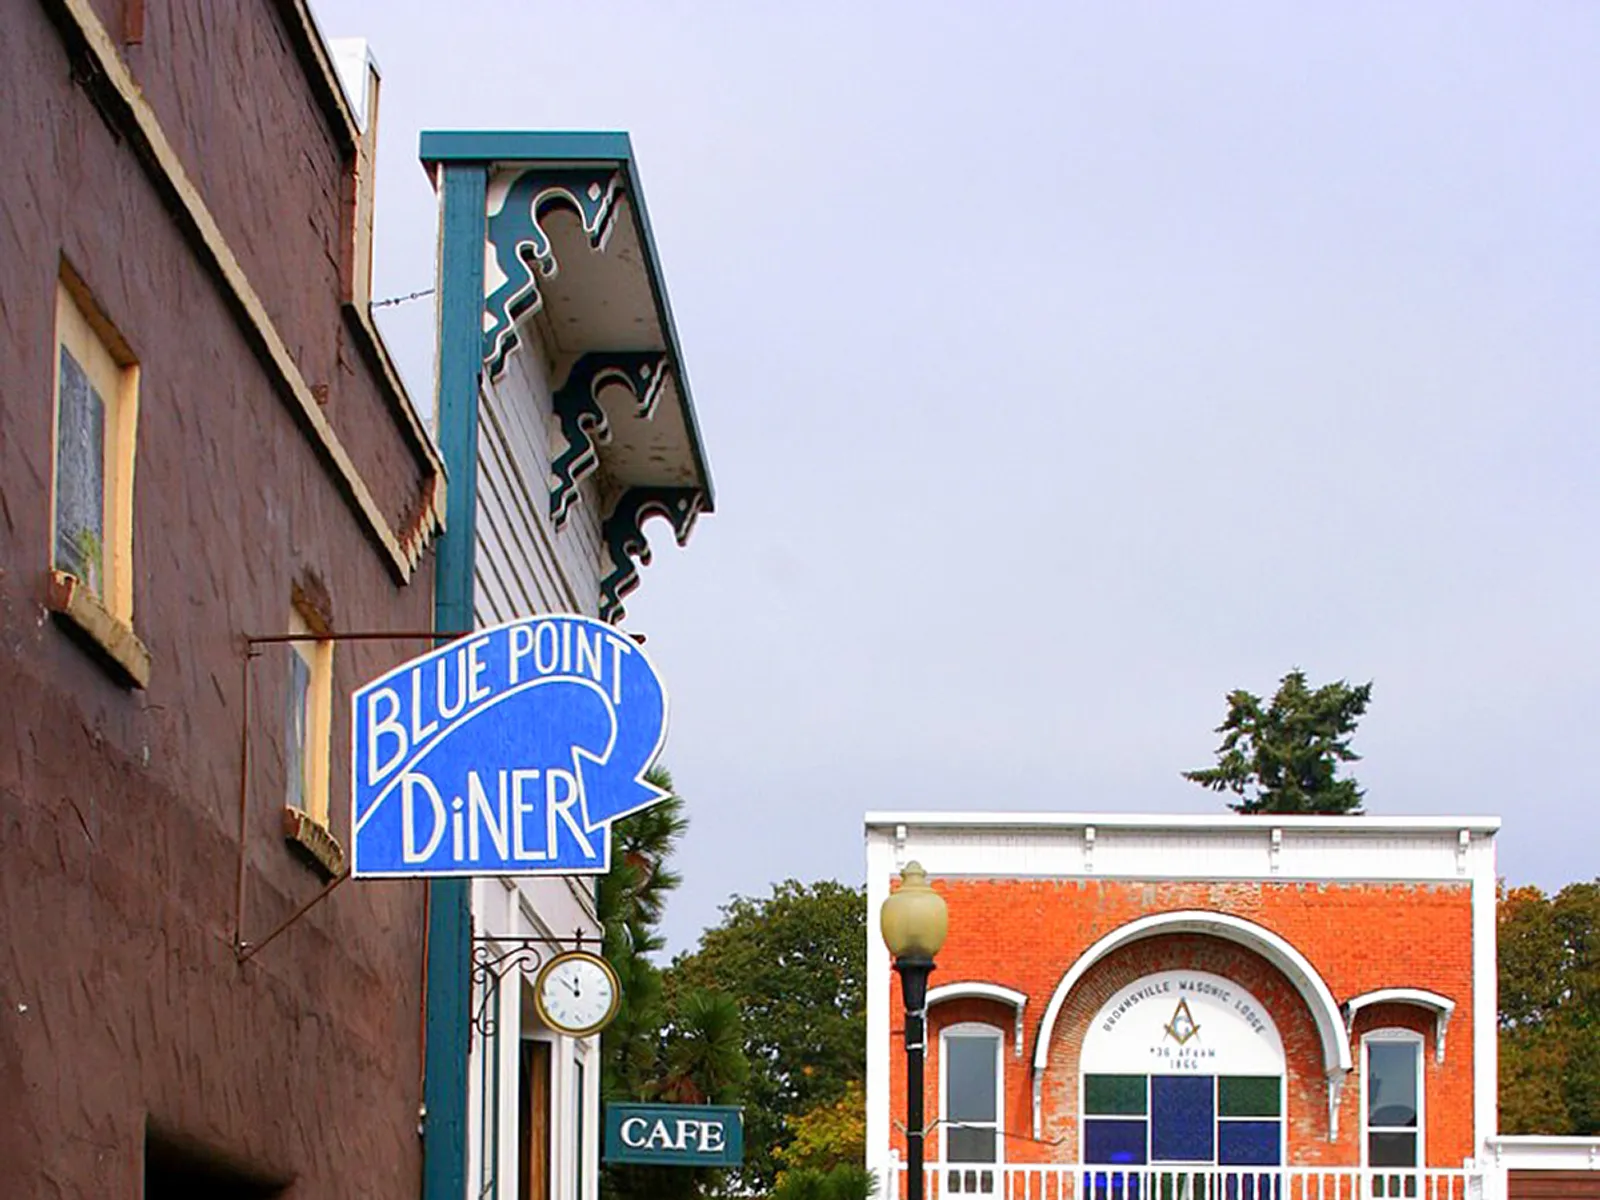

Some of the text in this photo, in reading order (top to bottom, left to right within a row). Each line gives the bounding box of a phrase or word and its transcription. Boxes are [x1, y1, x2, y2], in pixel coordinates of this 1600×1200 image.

[368, 620, 632, 787] BLUE POINT
[1178, 980, 1232, 1002] MASONIC
[1234, 999, 1267, 1034] LODGE
[620, 1117, 725, 1152] CAFE
